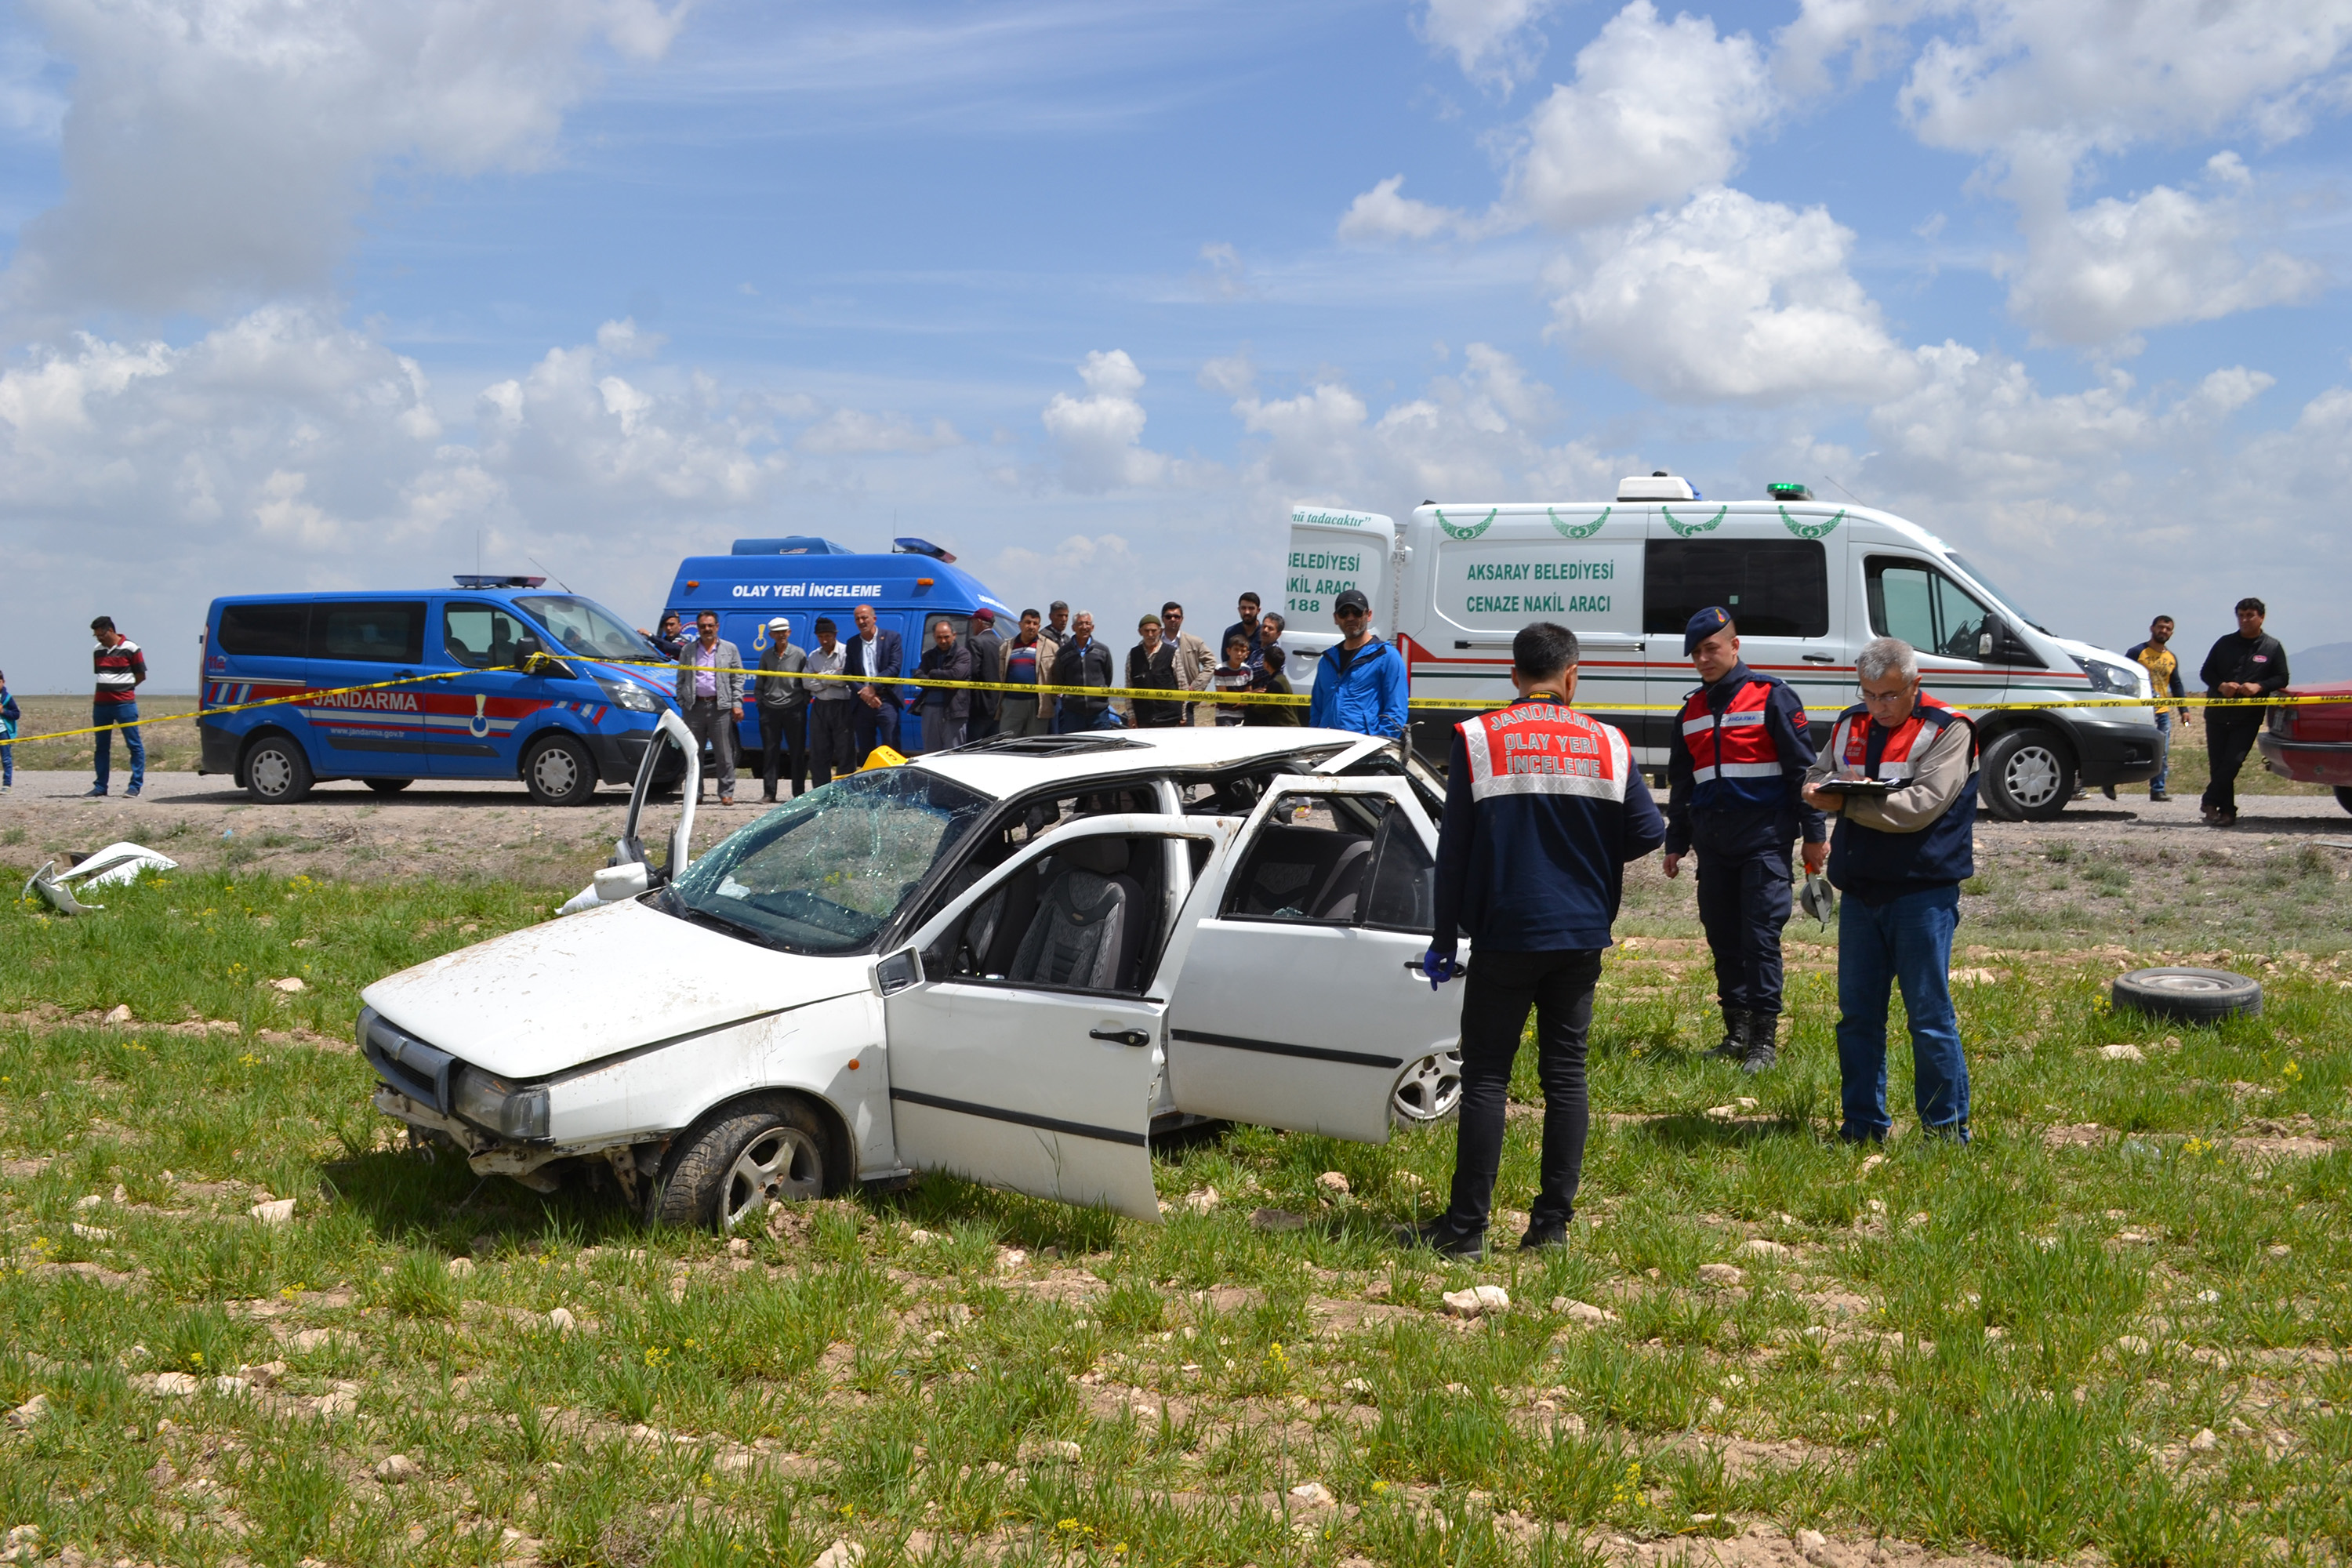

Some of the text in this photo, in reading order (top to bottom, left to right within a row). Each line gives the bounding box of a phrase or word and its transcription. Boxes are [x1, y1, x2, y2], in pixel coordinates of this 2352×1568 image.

[1467, 559, 1614, 581] AKSARAY BELEDİYESİ
[732, 583, 882, 597] OLAY YERİ İNCELEME
[1286, 574, 1312, 593] KİL
[1466, 591, 1610, 612] CENAZE NAKİL ARACI
[313, 690, 419, 712] JANDARMA
[1490, 703, 1603, 737] JANDARMA
[1504, 733, 1599, 755] OLAY YERİ
[1505, 750, 1601, 778] İNCELEME
